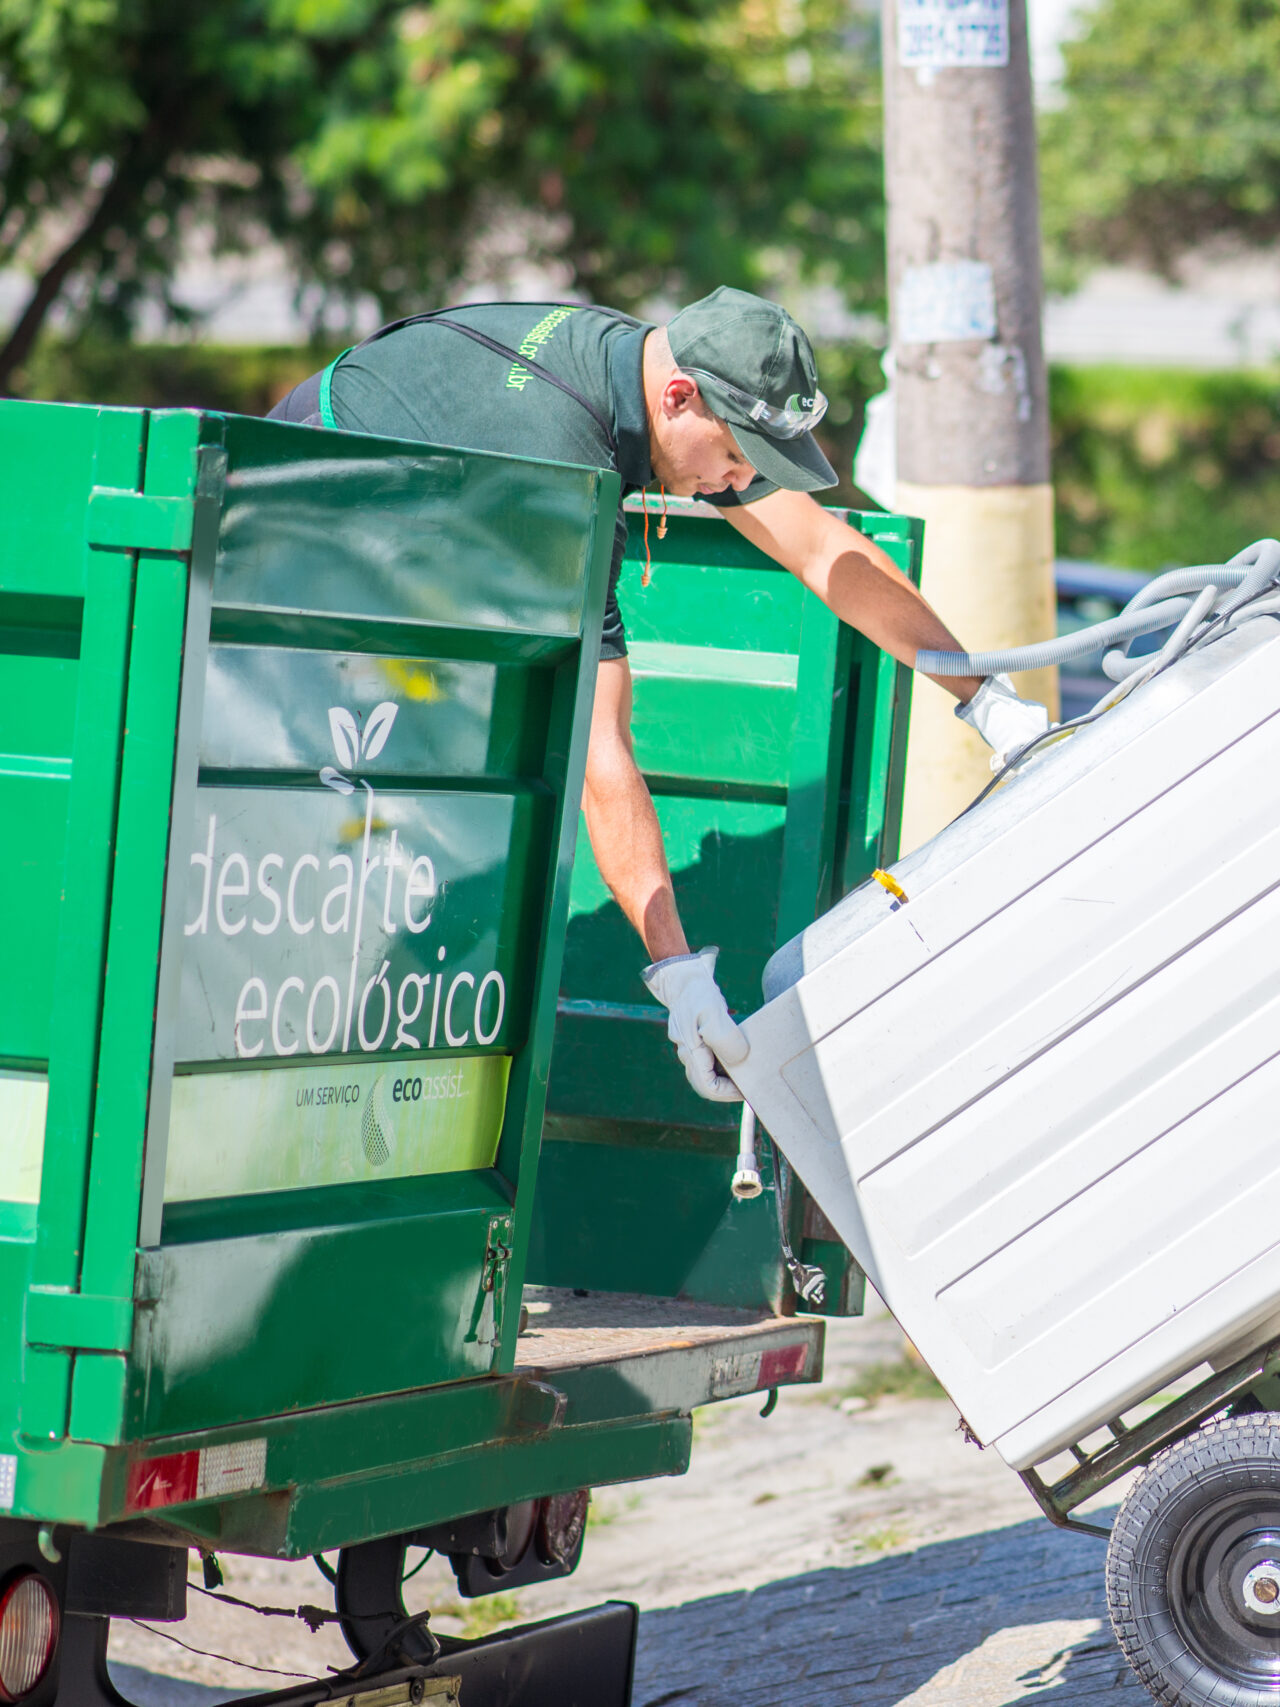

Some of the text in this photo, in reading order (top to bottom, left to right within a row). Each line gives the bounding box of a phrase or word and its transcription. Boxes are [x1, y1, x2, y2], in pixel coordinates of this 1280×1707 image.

[801, 397, 814, 408] ec
[184, 812, 436, 936] descarte
[234, 945, 506, 1058] ecológico
[296, 1084, 360, 1107] UM SERVIÇO
